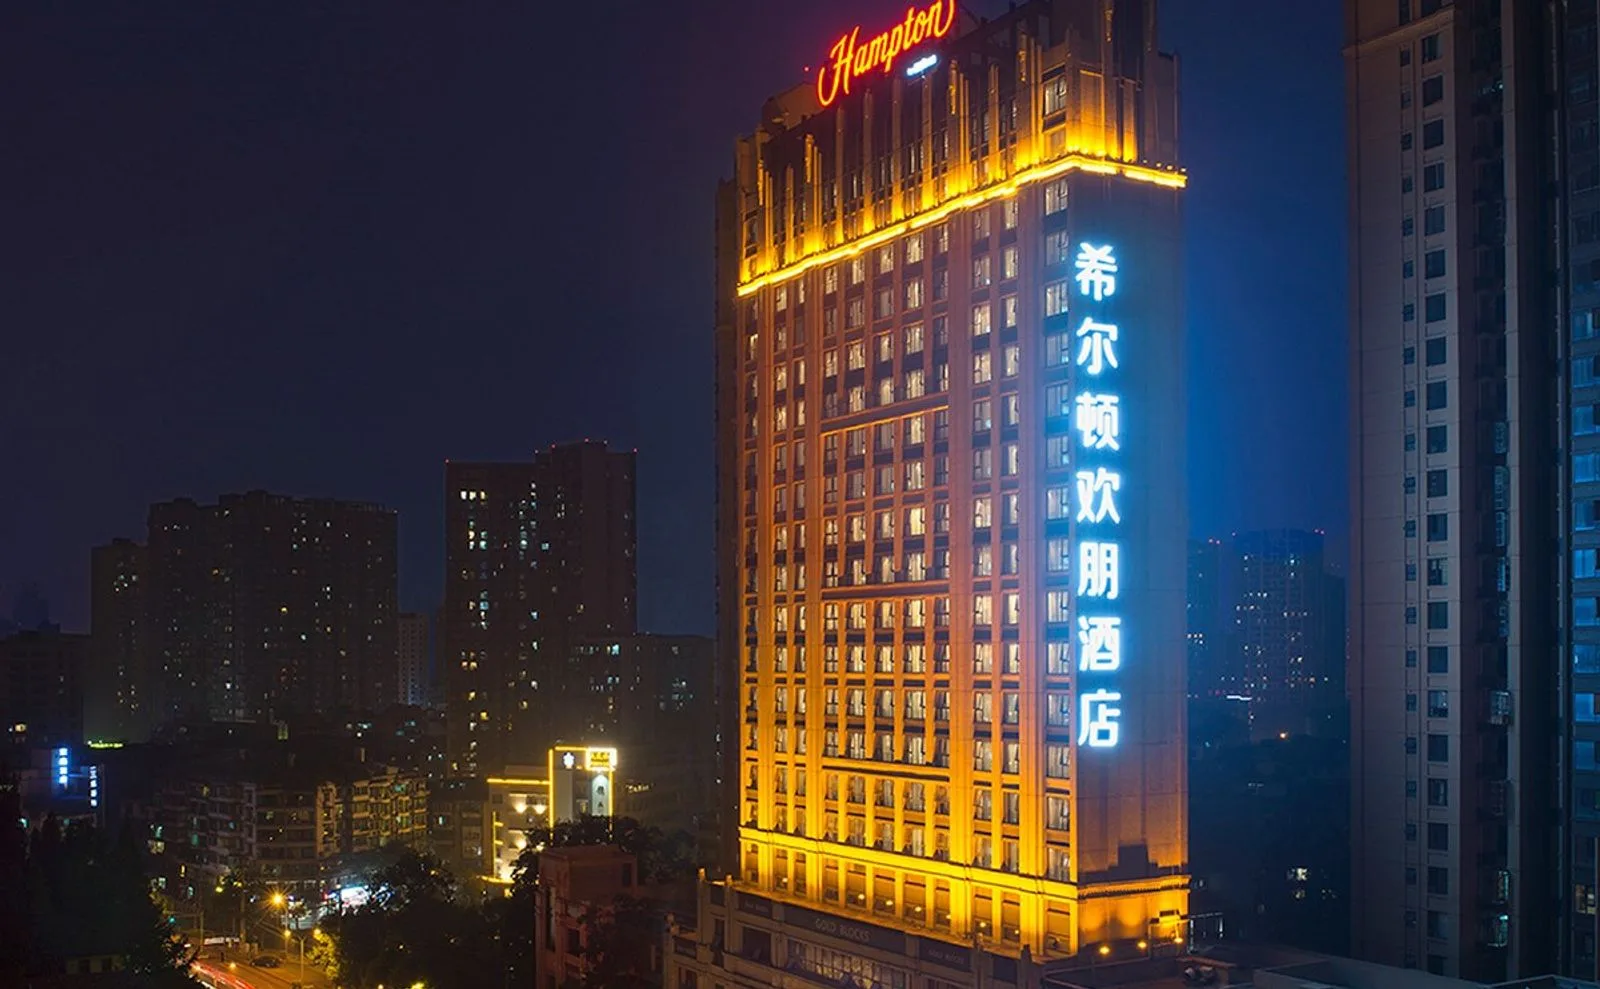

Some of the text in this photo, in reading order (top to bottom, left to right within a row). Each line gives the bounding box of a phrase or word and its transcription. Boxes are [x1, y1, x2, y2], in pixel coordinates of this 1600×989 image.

[818, 0, 955, 106] Hampton
[1075, 242, 1121, 748] 希尔顿欢朋酒店
